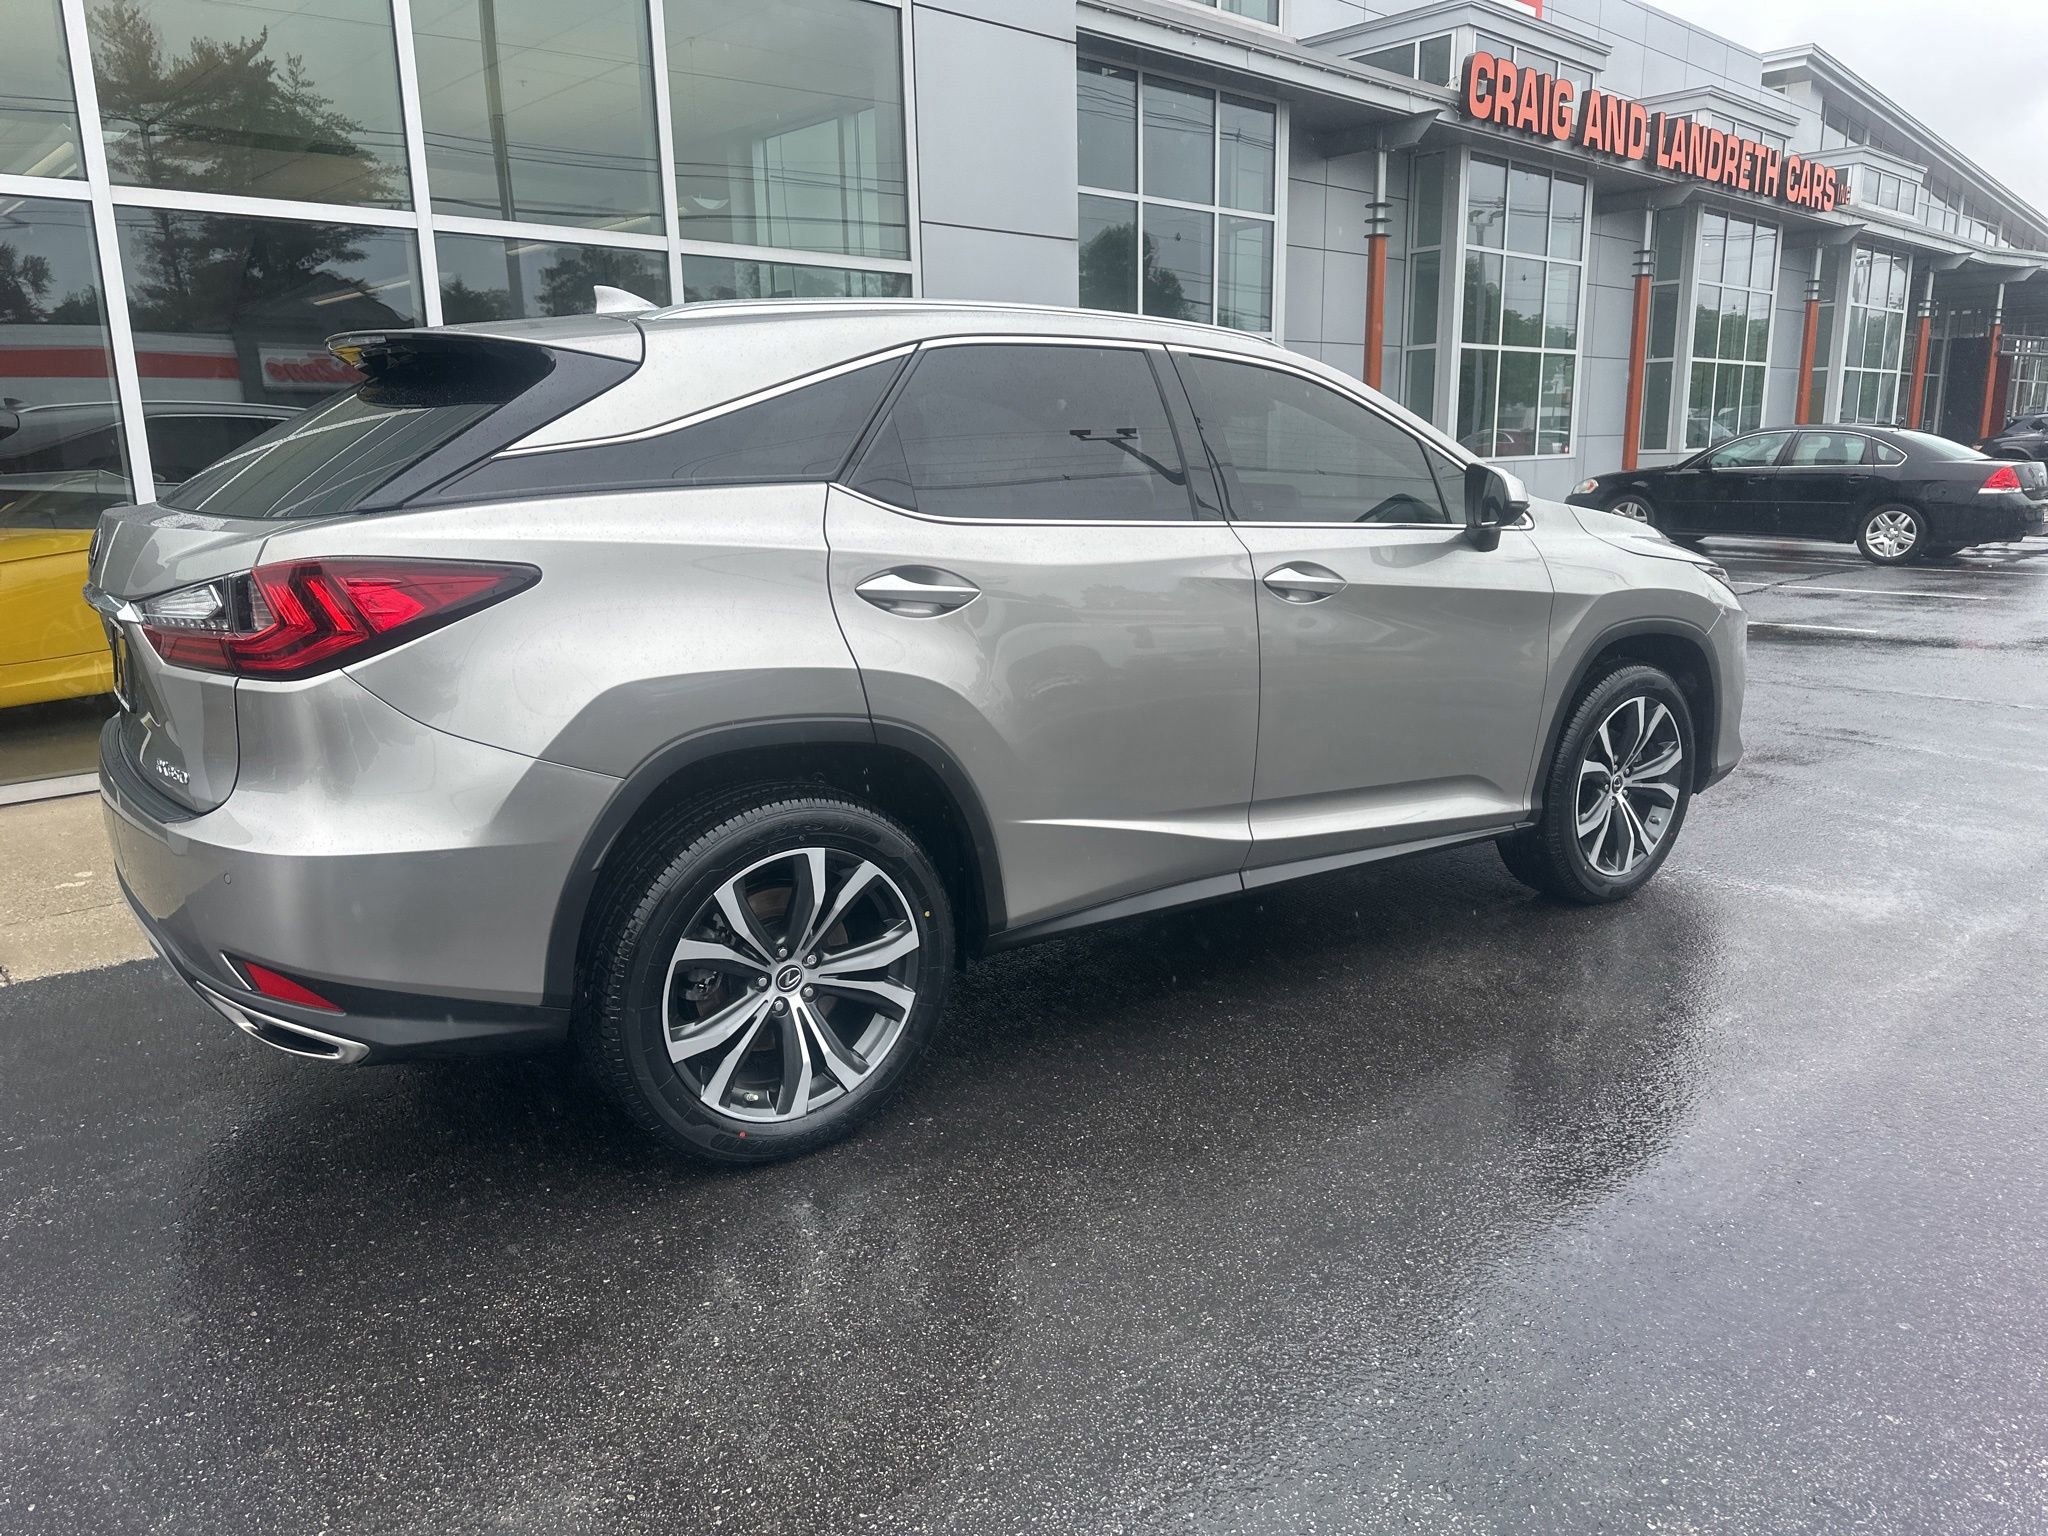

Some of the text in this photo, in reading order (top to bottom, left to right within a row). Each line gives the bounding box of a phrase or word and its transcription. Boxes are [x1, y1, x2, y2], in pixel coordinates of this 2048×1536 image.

[1468, 51, 1574, 141] CRAIG
[1582, 89, 1648, 160] AND
[1656, 112, 1783, 198] LANDRETH
[1786, 154, 1837, 212] CARS
